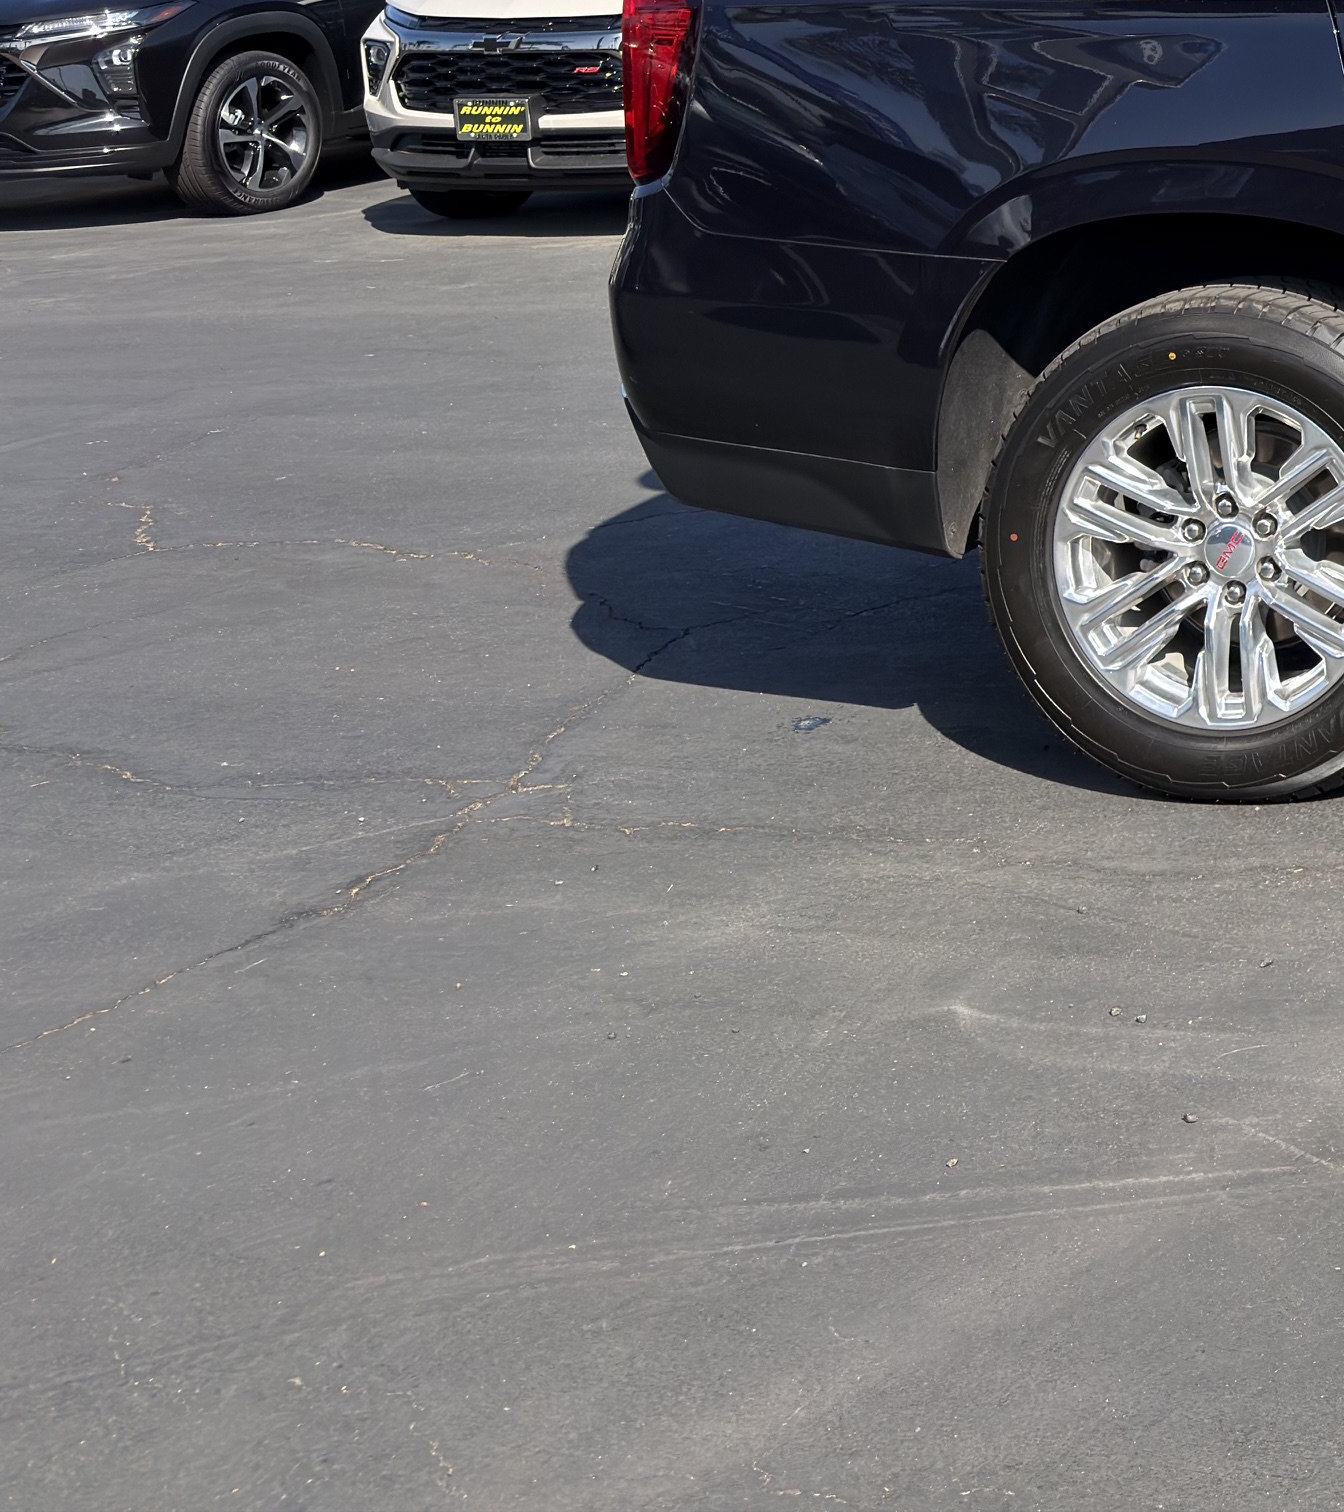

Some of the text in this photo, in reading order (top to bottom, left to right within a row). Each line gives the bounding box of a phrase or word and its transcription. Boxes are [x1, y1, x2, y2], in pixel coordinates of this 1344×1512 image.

[460, 106, 525, 115] RUNNIN'
[485, 115, 502, 123] to
[461, 123, 524, 133] BUNNIN
[1215, 529, 1246, 571] GMC
